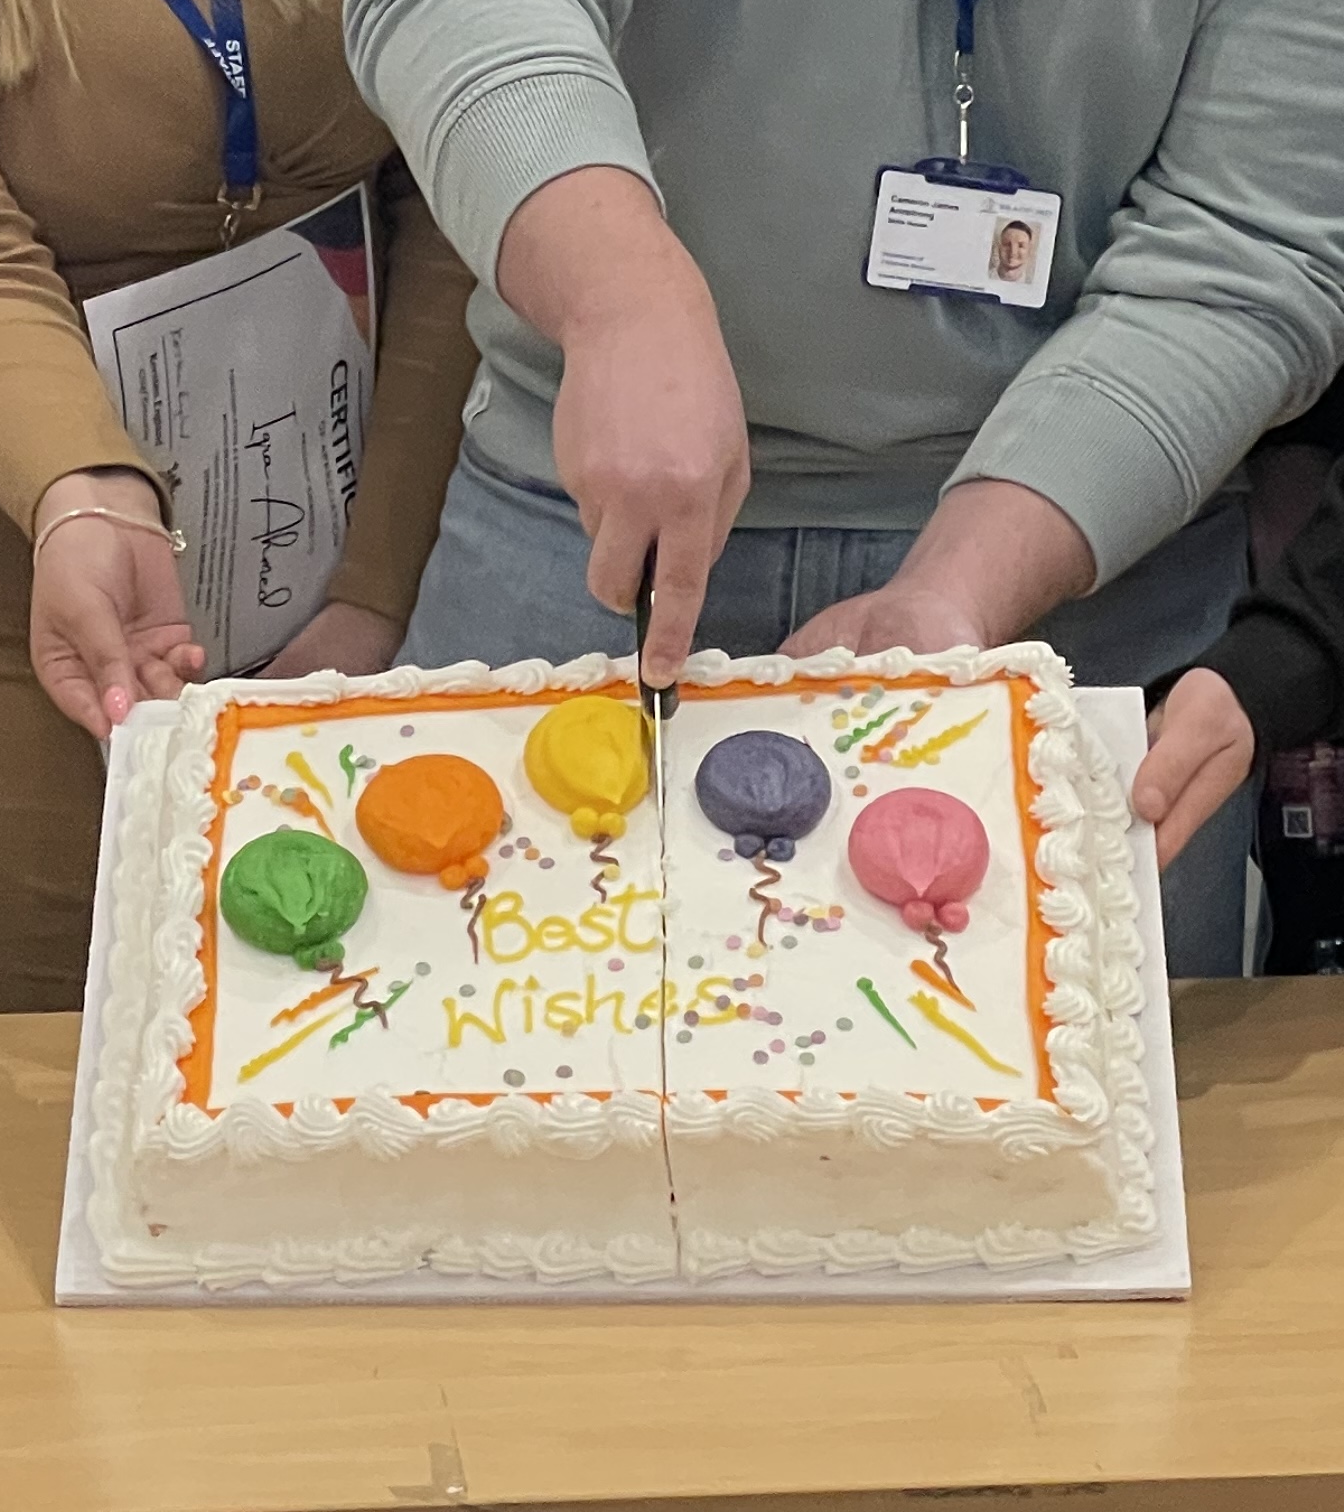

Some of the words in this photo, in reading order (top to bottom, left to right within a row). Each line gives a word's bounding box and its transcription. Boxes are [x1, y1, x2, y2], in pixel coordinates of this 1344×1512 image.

[244, 400, 298, 480] Iqra
[251, 485, 305, 607] Ahmed
[482, 883, 660, 964] Best
[442, 973, 742, 1048] Wishes
